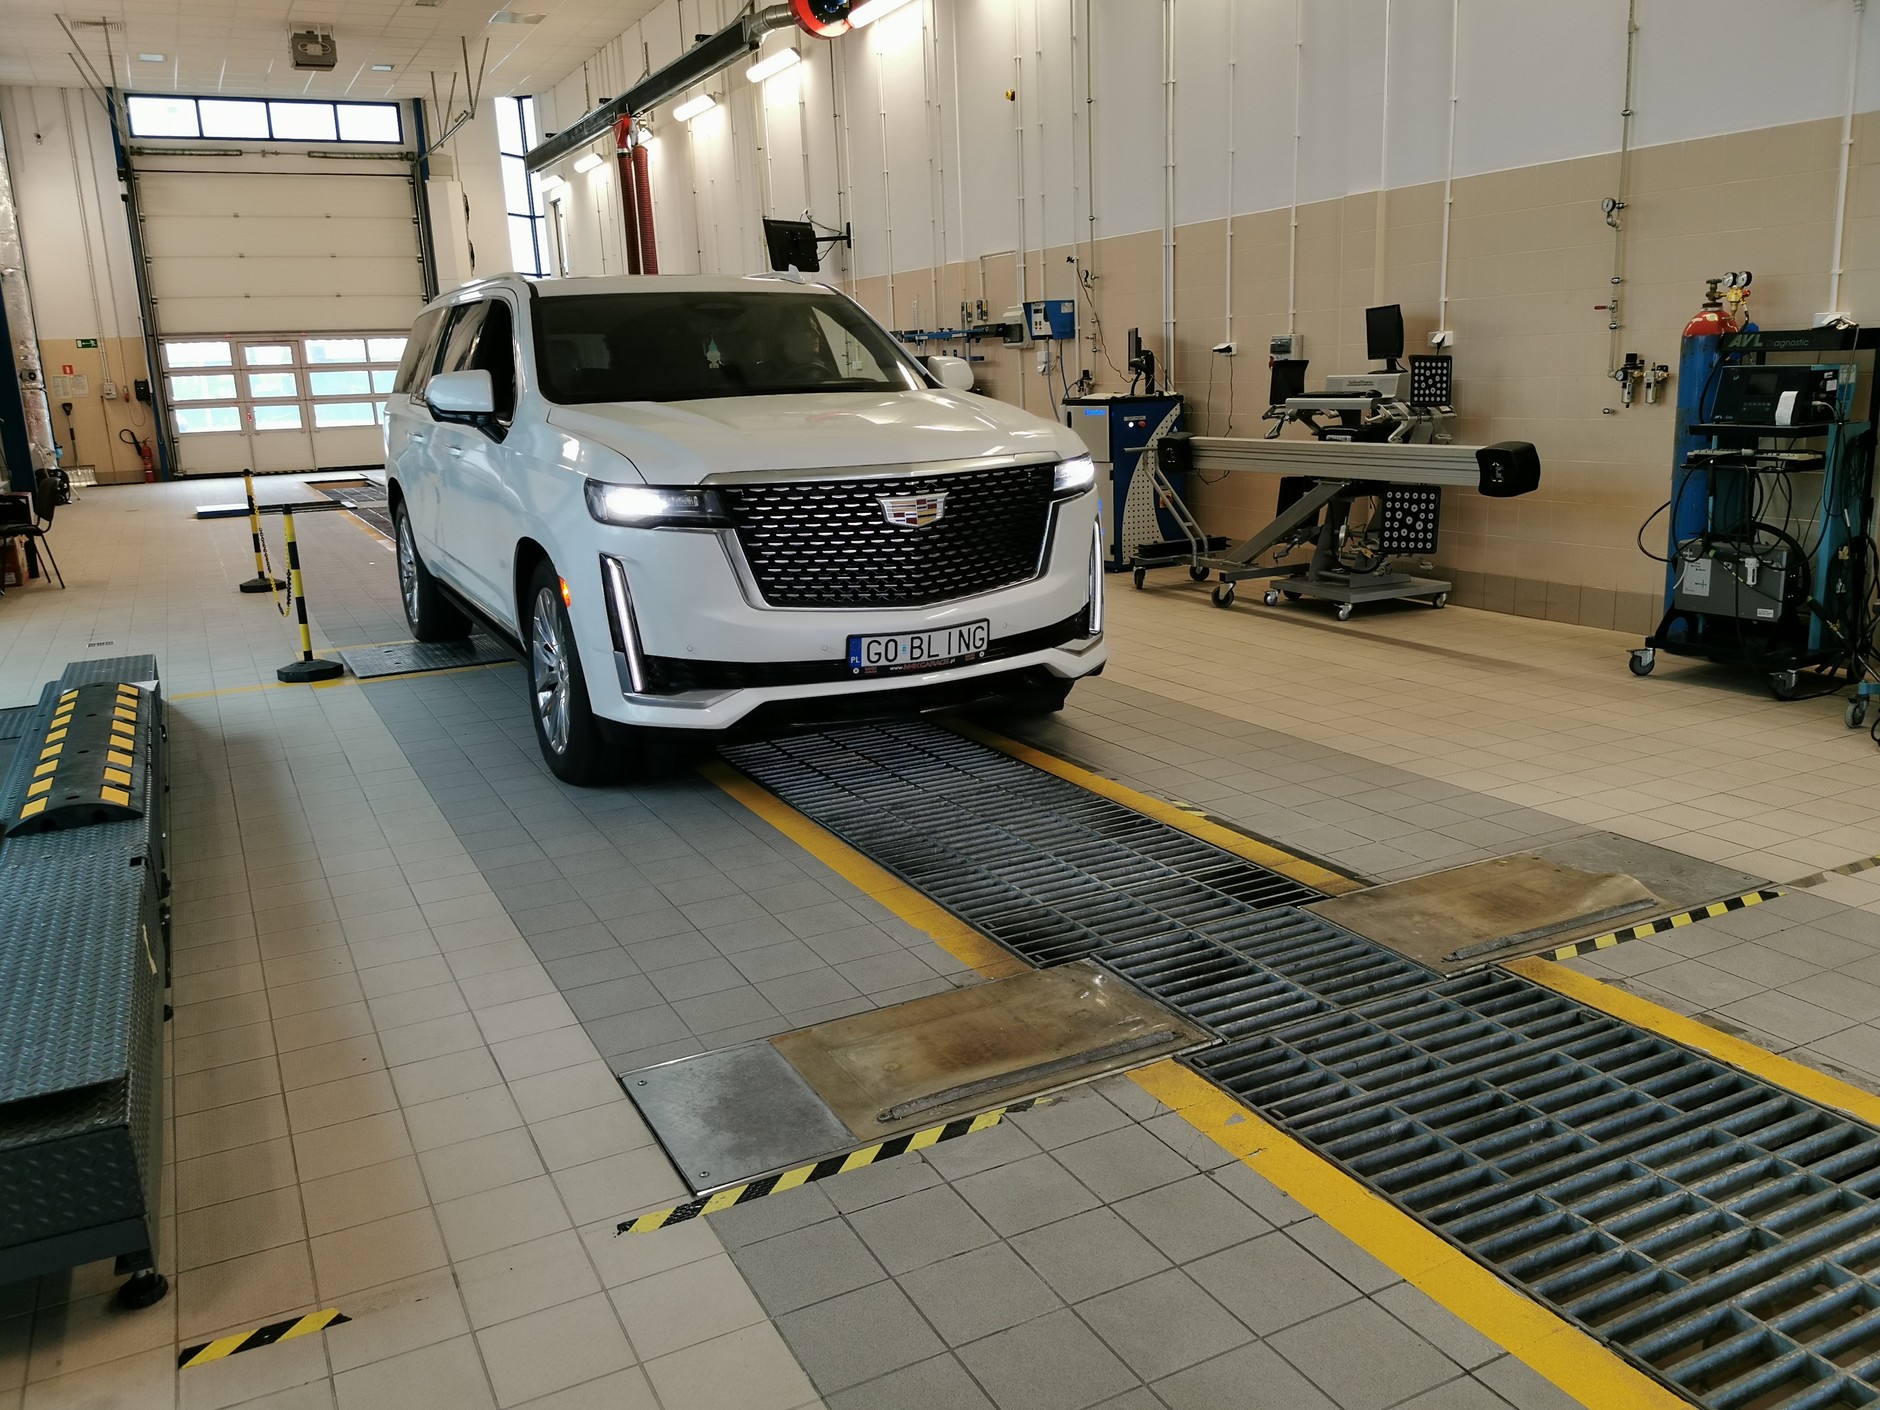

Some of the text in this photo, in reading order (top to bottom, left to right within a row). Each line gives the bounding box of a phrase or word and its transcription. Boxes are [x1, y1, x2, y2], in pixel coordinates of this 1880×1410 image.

[1728, 333, 1763, 348] AVL
[910, 626, 985, 660] BLING
[850, 656, 861, 664] PL
